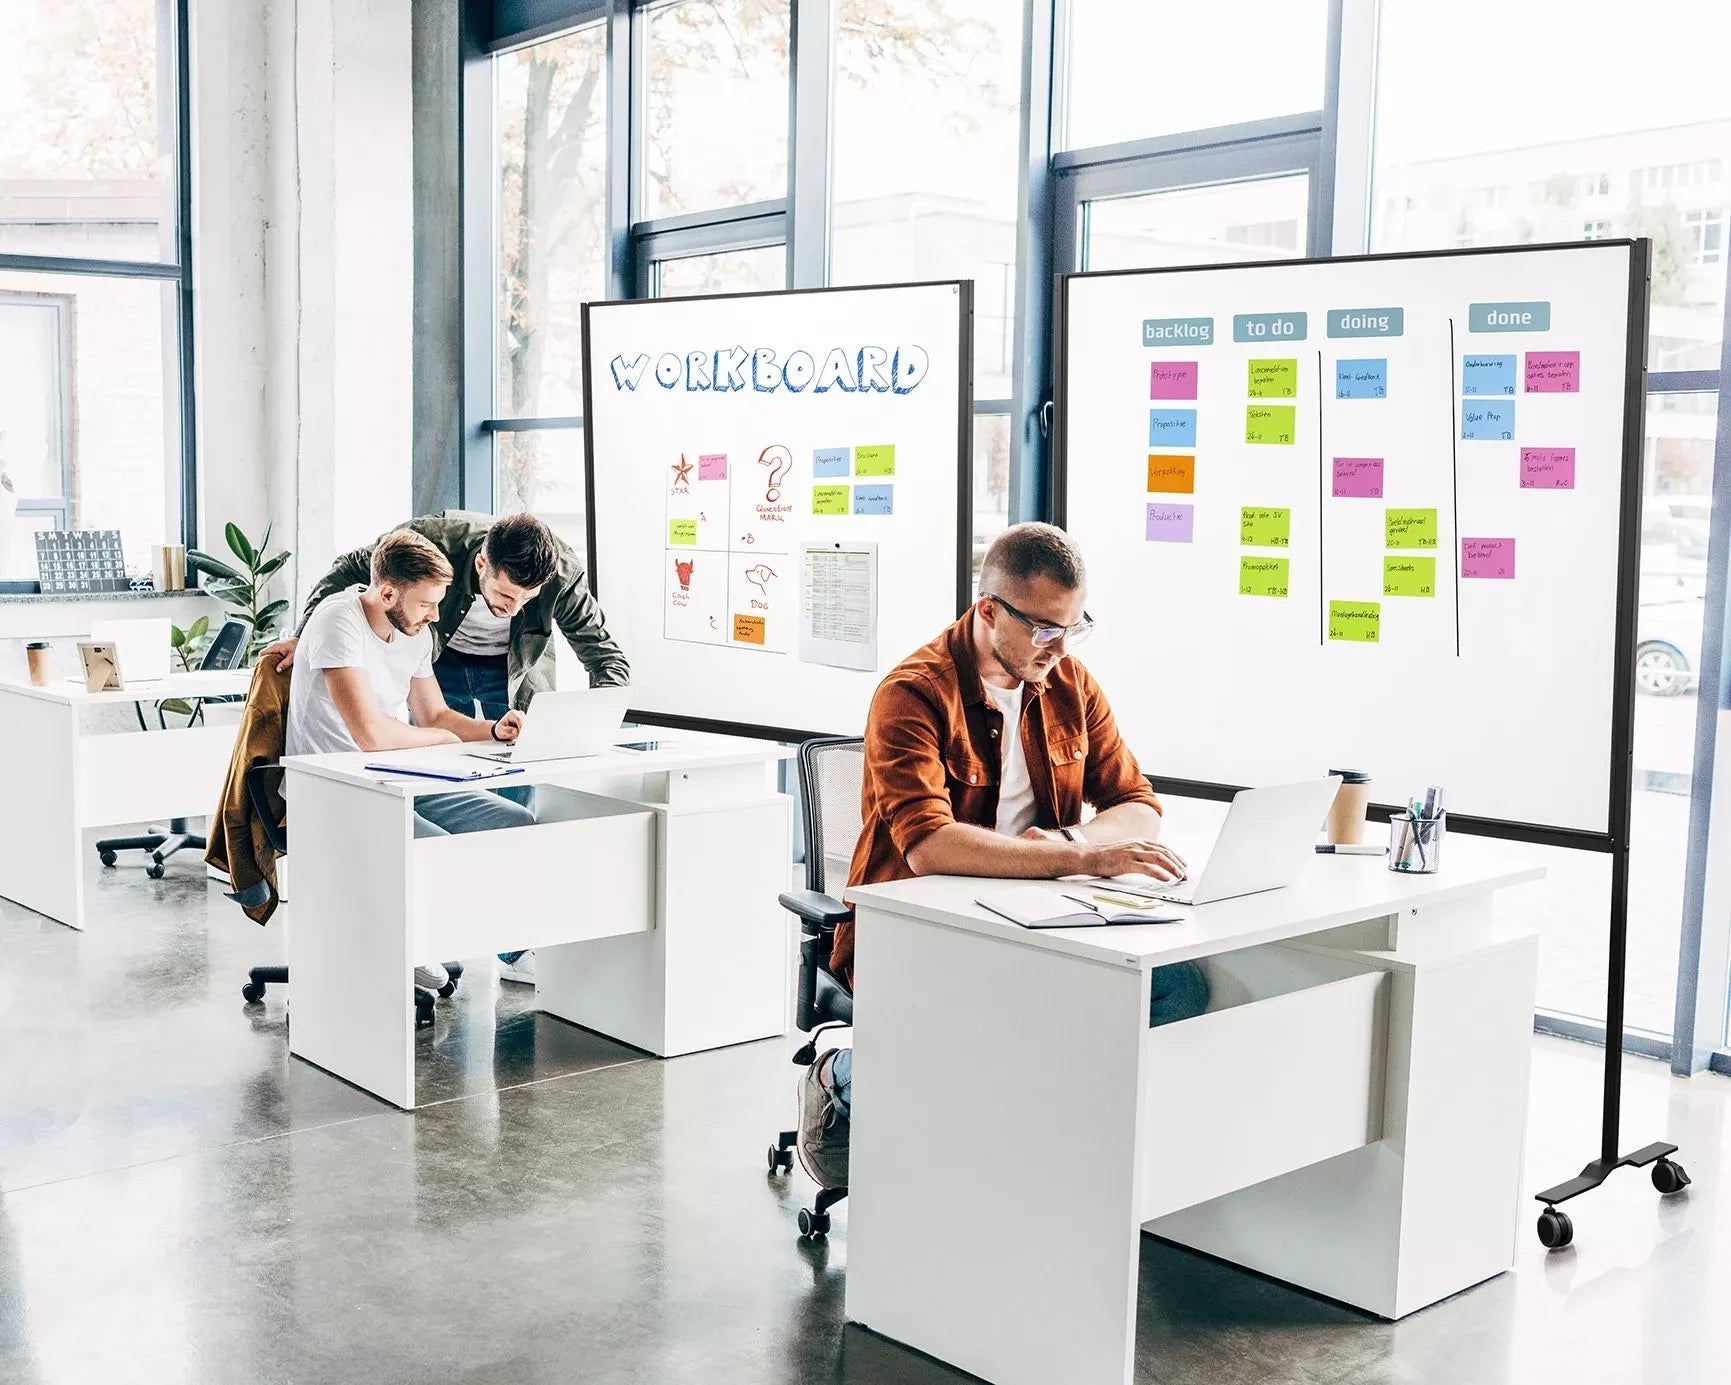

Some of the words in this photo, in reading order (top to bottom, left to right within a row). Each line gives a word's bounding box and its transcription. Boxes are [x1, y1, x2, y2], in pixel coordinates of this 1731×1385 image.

[1340, 314, 1389, 331] doing
[1487, 310, 1532, 325] done
[1146, 323, 1209, 340] backlog
[1246, 320, 1266, 336] to
[1271, 319, 1294, 335] do
[610, 345, 929, 395] WORKBOARD
[671, 487, 690, 496] STAR
[759, 514, 784, 523] MARK
[38, 532, 45, 540] S
[48, 532, 57, 540] M
[87, 531, 95, 539] T
[100, 531, 105, 539] F
[112, 531, 118, 539] S
